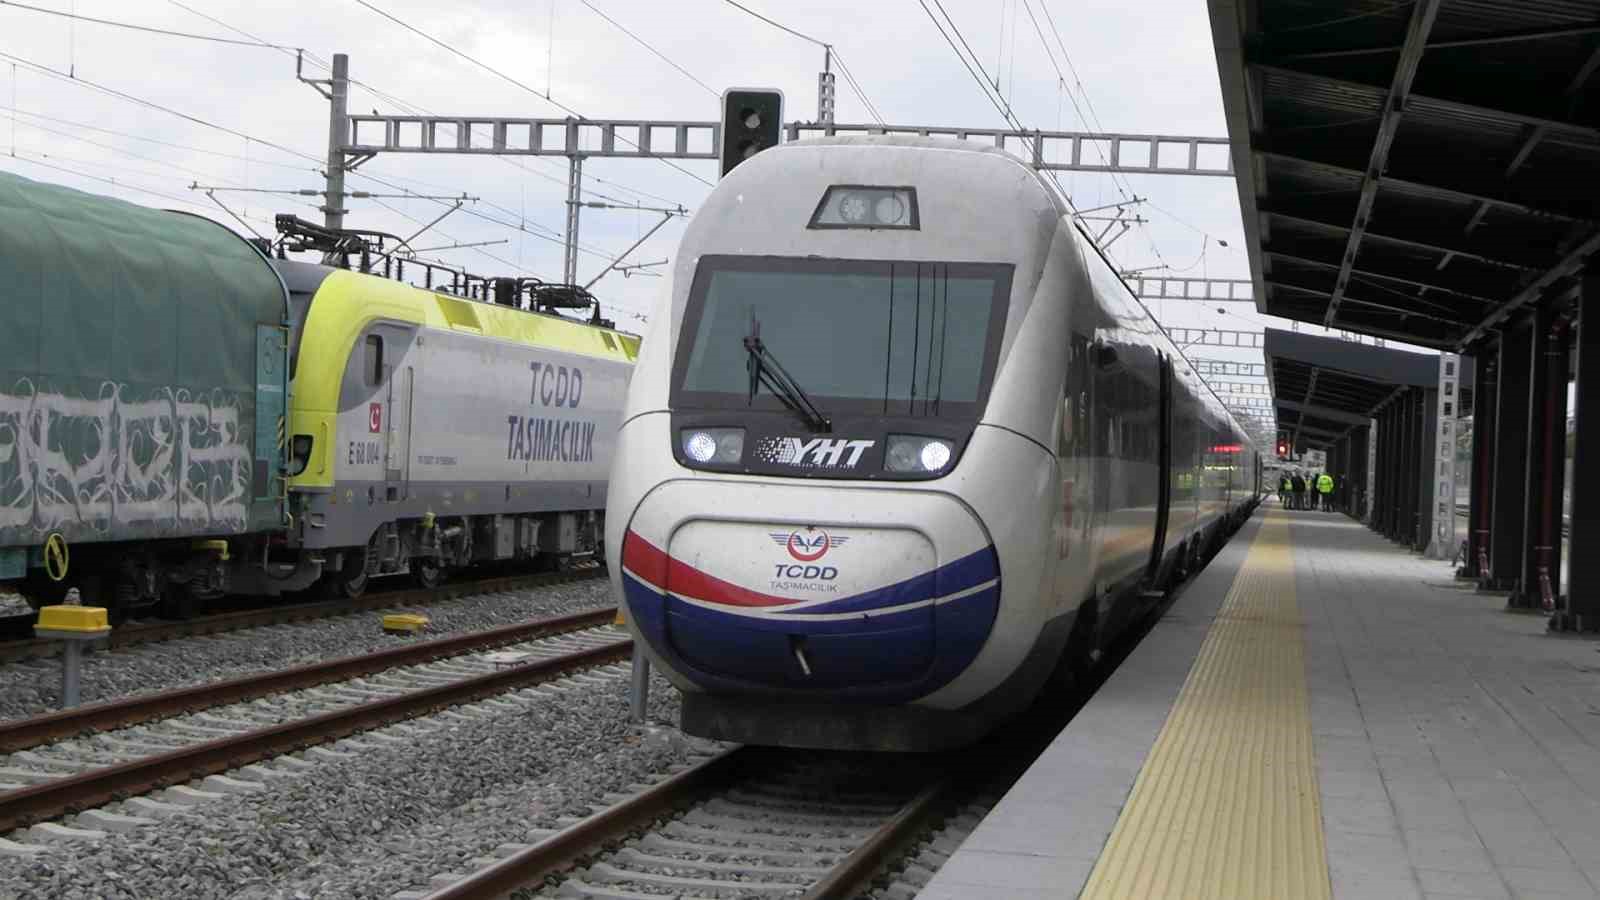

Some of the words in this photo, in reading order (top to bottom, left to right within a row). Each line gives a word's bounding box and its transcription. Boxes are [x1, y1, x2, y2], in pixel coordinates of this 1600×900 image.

[530, 361, 582, 408] TCDD
[791, 437, 875, 465] YHT
[775, 564, 839, 580] TCDD
